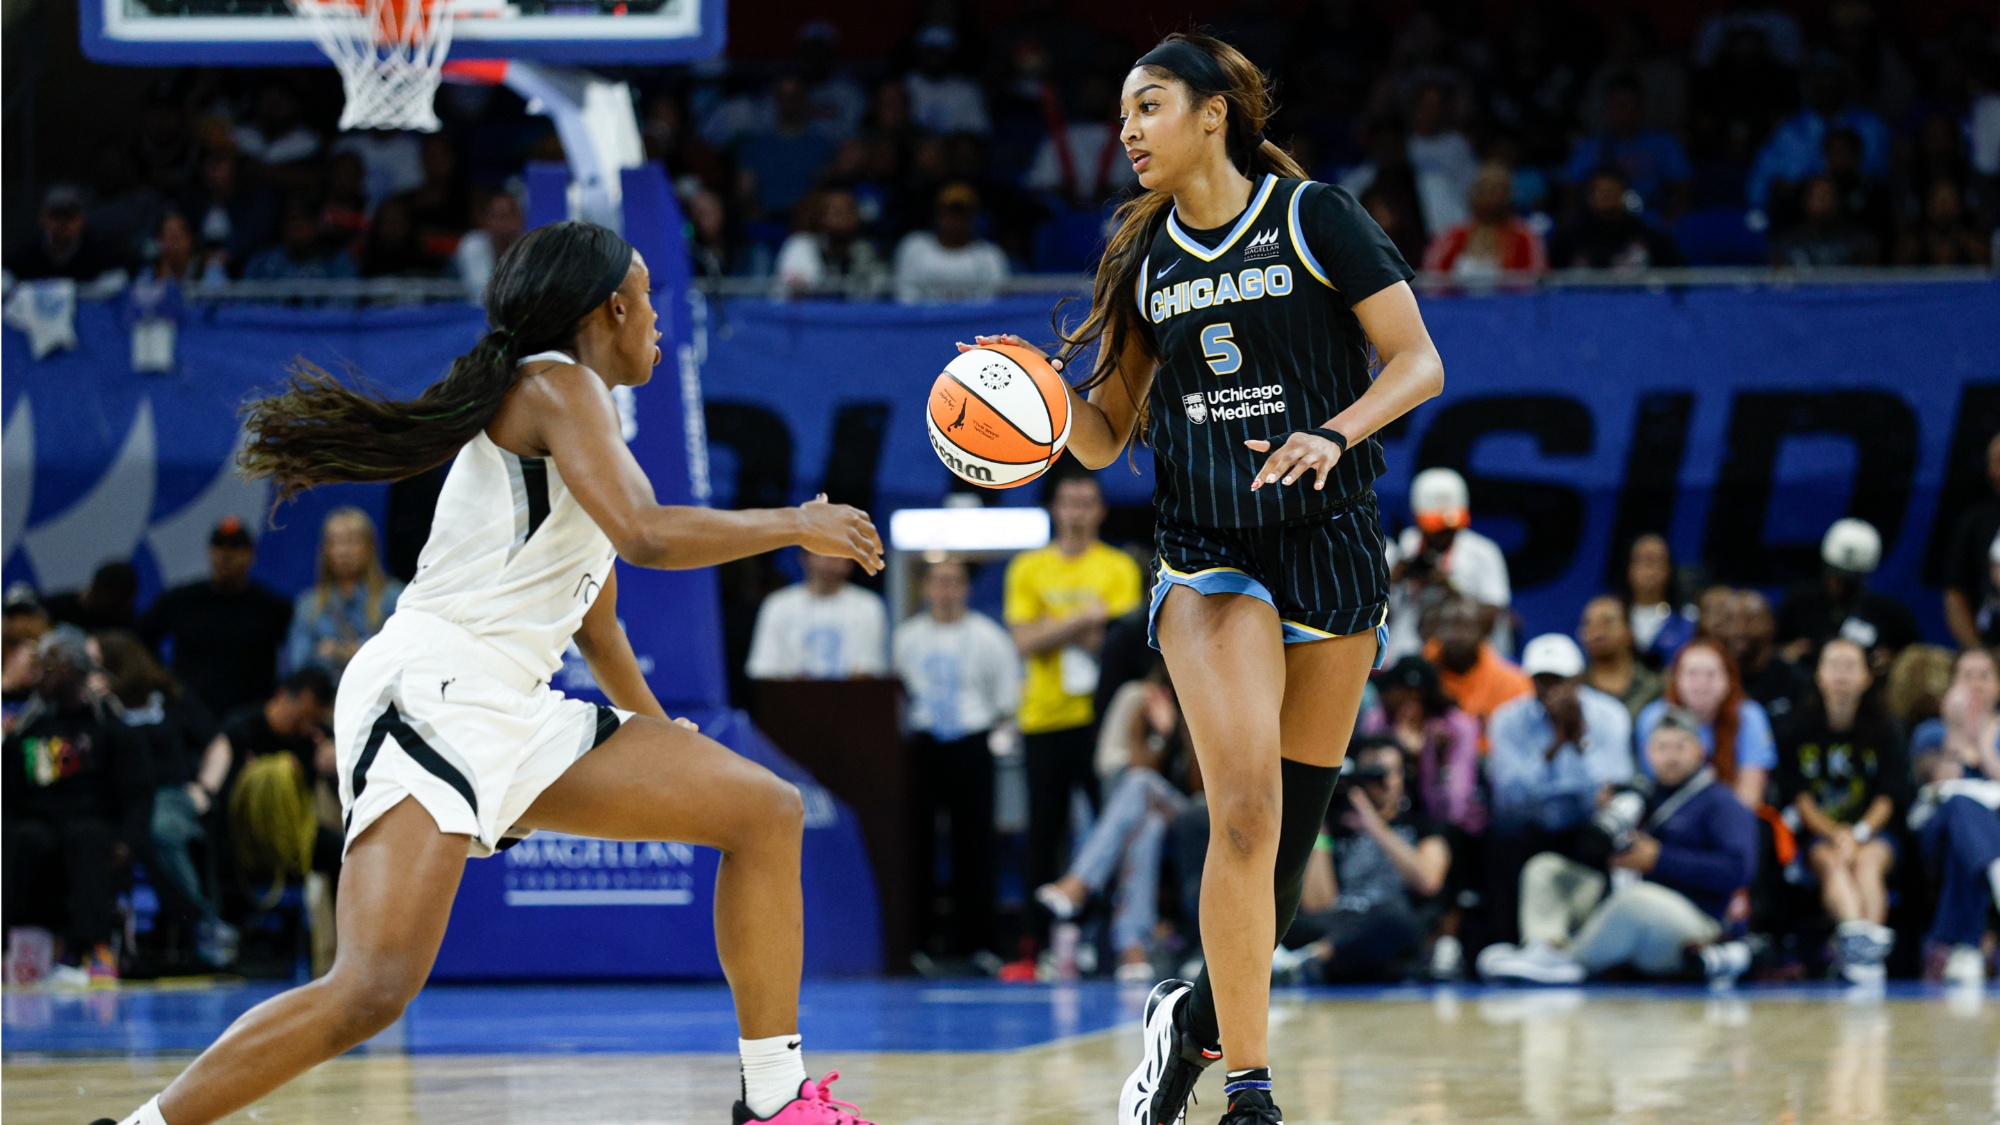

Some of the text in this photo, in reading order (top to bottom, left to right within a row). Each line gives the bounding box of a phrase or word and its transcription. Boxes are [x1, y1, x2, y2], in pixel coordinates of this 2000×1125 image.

[1244, 244, 1279, 255] MAGELLAN
[1151, 264, 1293, 324] CHICAGO
[1200, 322, 1242, 376] 5
[1207, 384, 1283, 404] UChicago
[1210, 400, 1286, 422] Medicine
